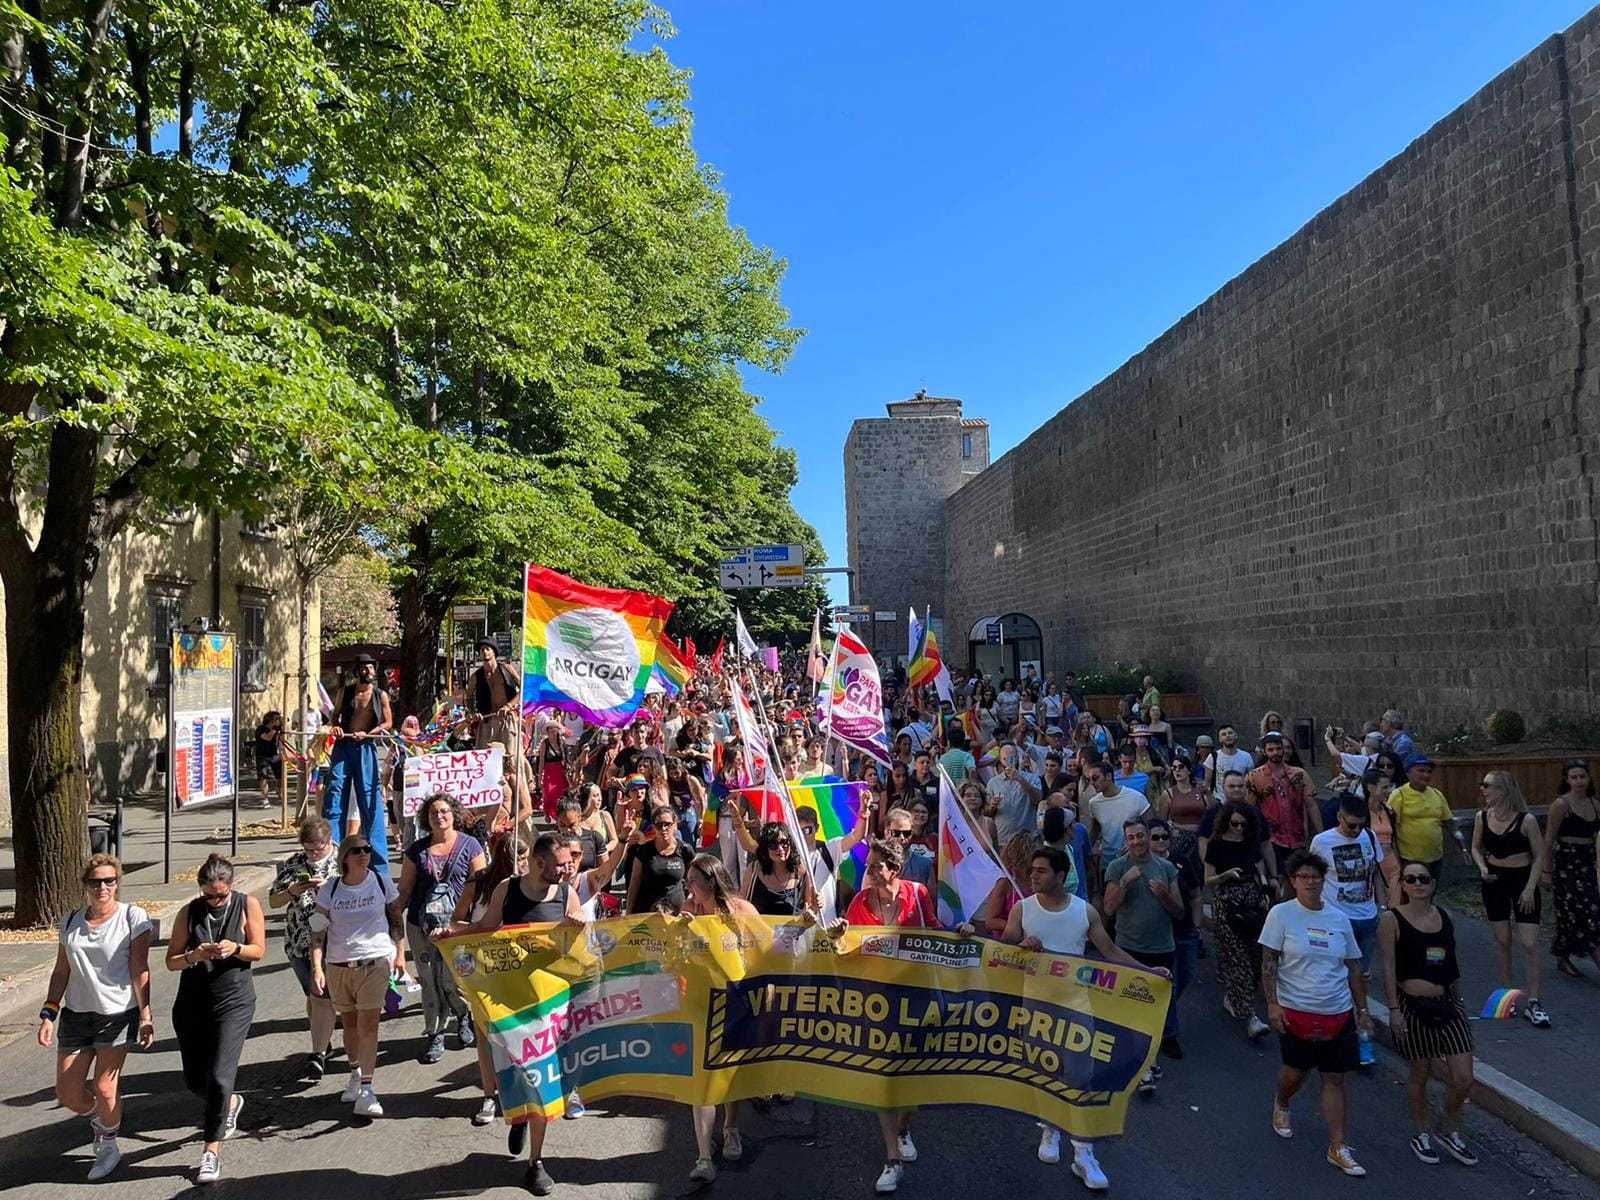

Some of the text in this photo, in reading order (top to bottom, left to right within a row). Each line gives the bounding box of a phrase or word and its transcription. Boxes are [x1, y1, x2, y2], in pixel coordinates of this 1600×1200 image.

[555, 657, 633, 681] ARCIGAY
[423, 768, 484, 782] TUTT3
[483, 943, 538, 960] REGIONE
[628, 938, 667, 948] ARCIGAY
[905, 937, 977, 955] 800.713.713
[484, 959, 522, 974] LAZIO
[747, 985, 1116, 1064] VITERBO LAZIO PRIDE
[779, 1016, 1061, 1073] FUORI DAL MEDIOEVO
[547, 1039, 651, 1084] LUGLIO
